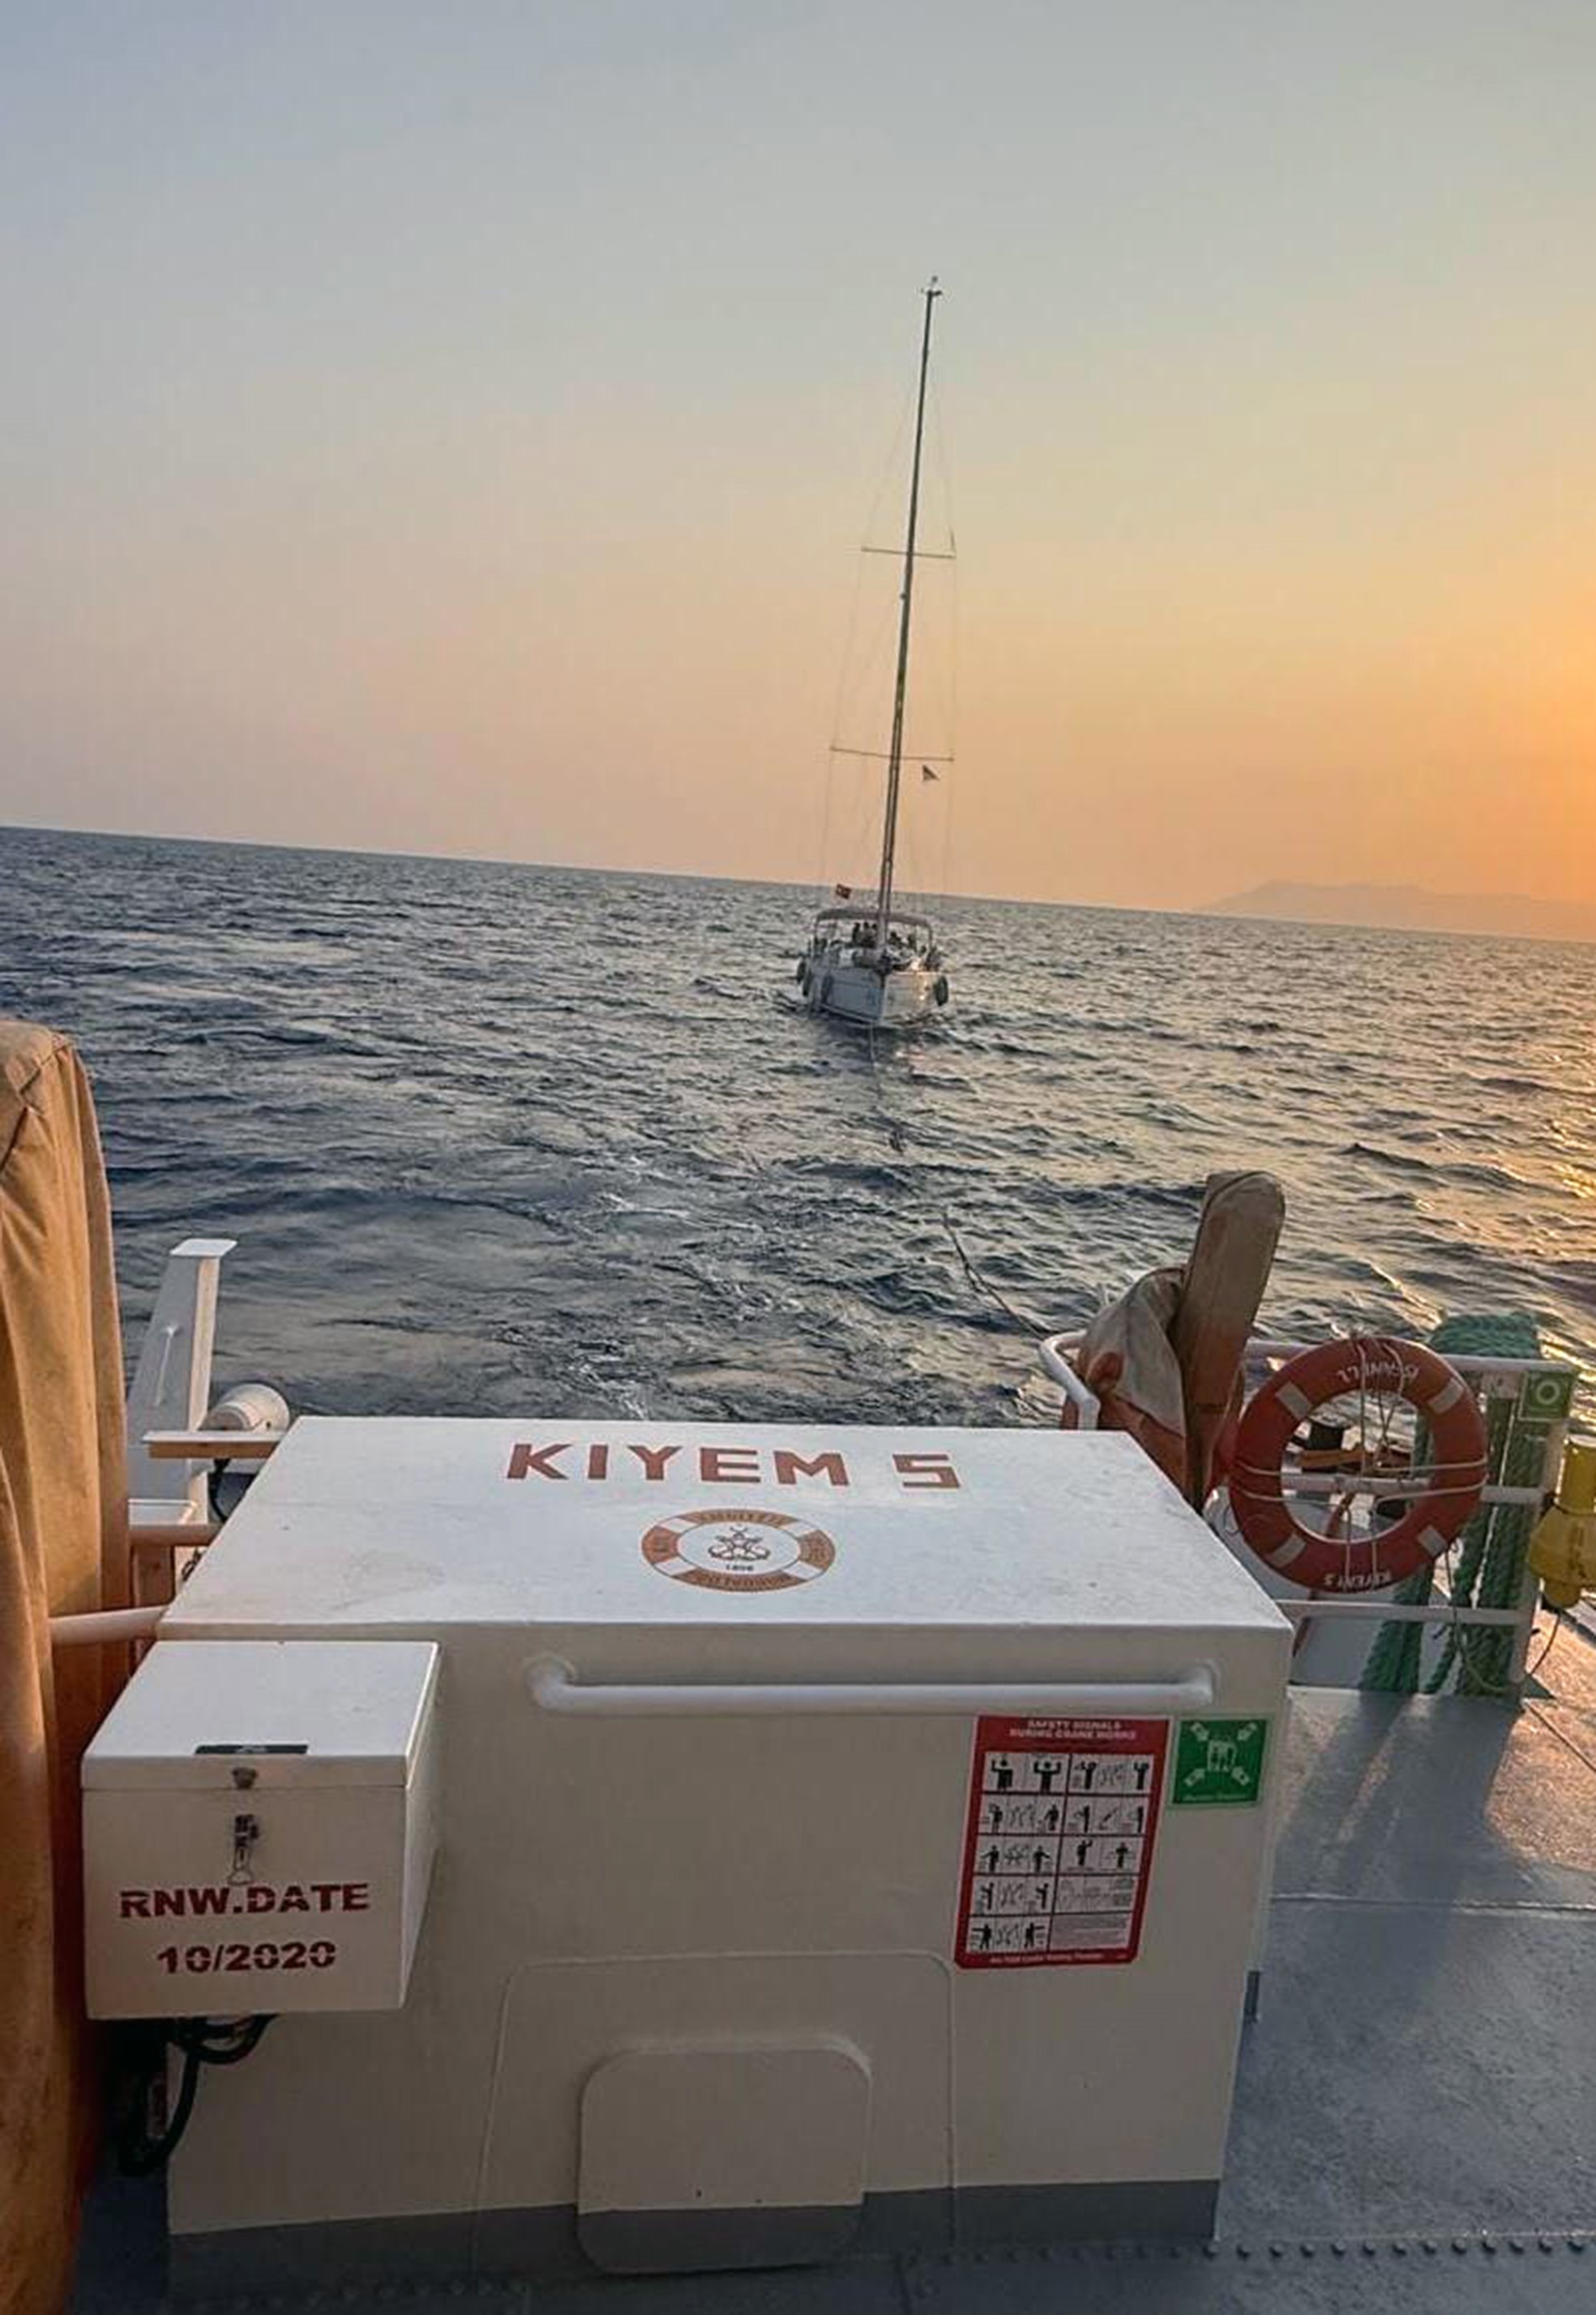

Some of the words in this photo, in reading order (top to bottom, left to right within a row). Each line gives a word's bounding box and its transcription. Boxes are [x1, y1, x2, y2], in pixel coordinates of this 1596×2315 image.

[506, 1443, 851, 1487] KIYEM
[119, 1883, 370, 1919] RNW.DATE
[156, 1941, 337, 1975] 10/2020
